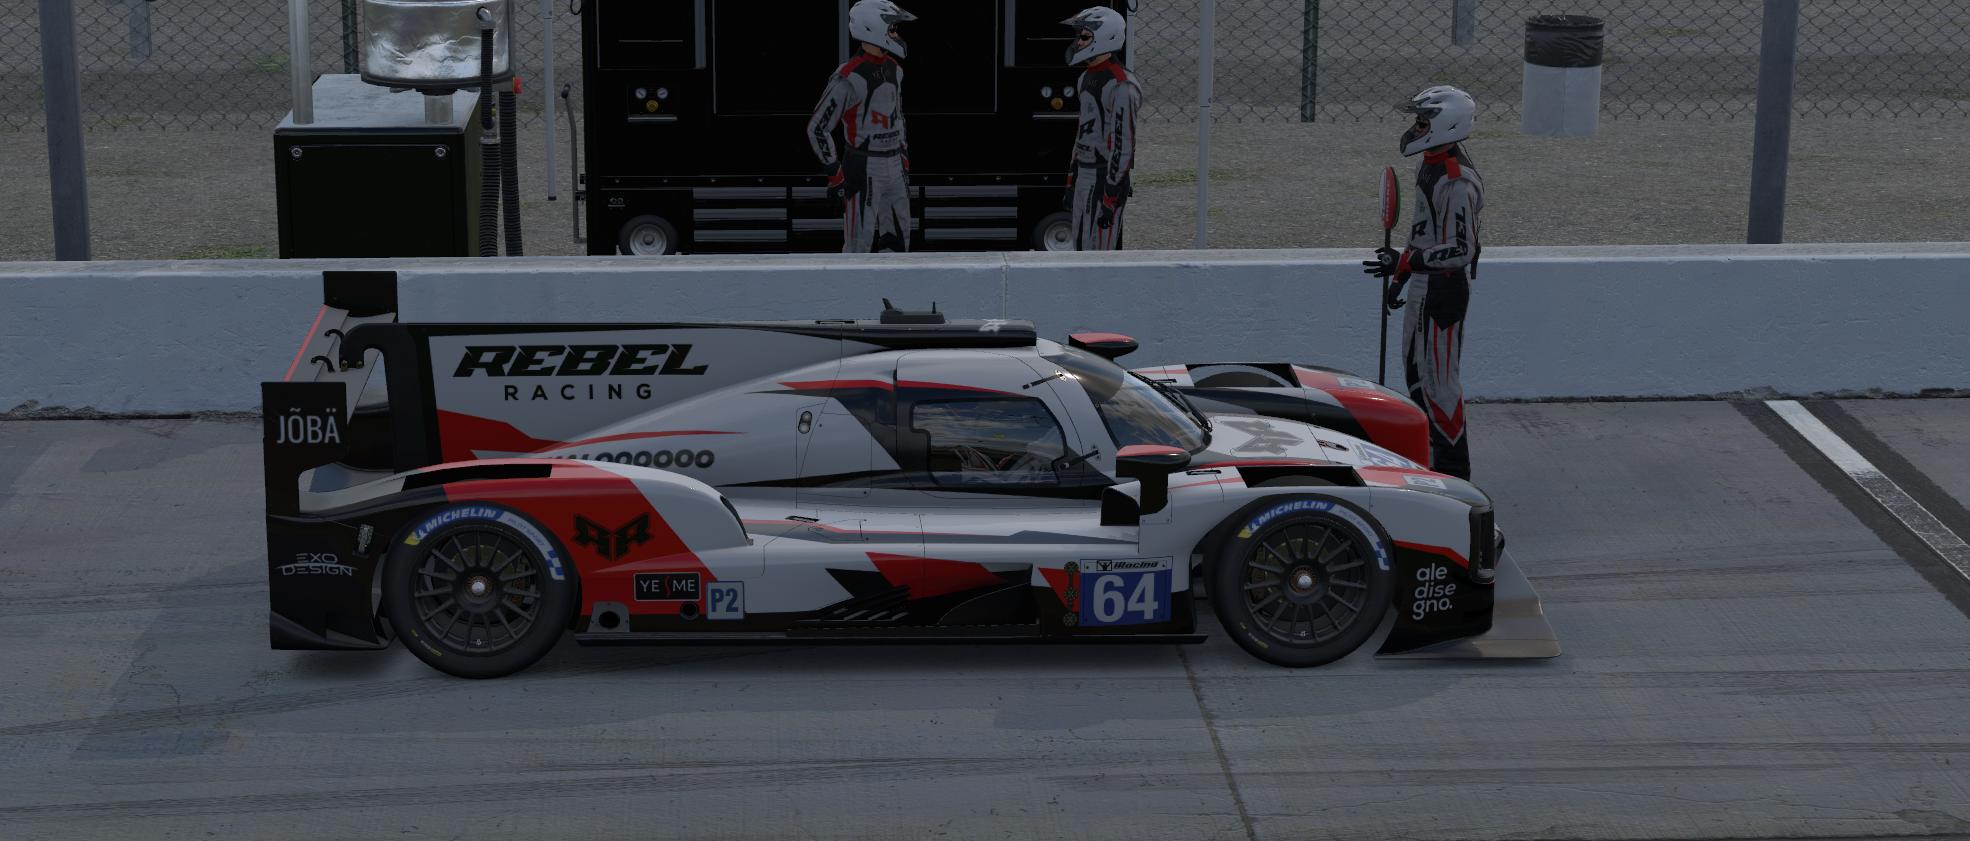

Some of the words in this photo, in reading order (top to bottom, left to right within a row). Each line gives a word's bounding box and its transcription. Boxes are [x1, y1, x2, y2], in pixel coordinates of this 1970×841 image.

[452, 343, 709, 378] REBEL
[504, 383, 653, 401] RACING
[276, 407, 341, 444] JÕBÄ
[426, 507, 497, 532] MICHELIN
[1259, 501, 1328, 525] MICHELIN
[280, 562, 354, 577] DESIGN
[296, 552, 338, 563] EXO
[1114, 560, 1159, 569] iRacing
[1416, 562, 1448, 581] ale
[711, 588, 739, 613] P2
[1093, 572, 1158, 623] 64
[1414, 581, 1457, 598] dise
[1412, 597, 1453, 621] gno.
